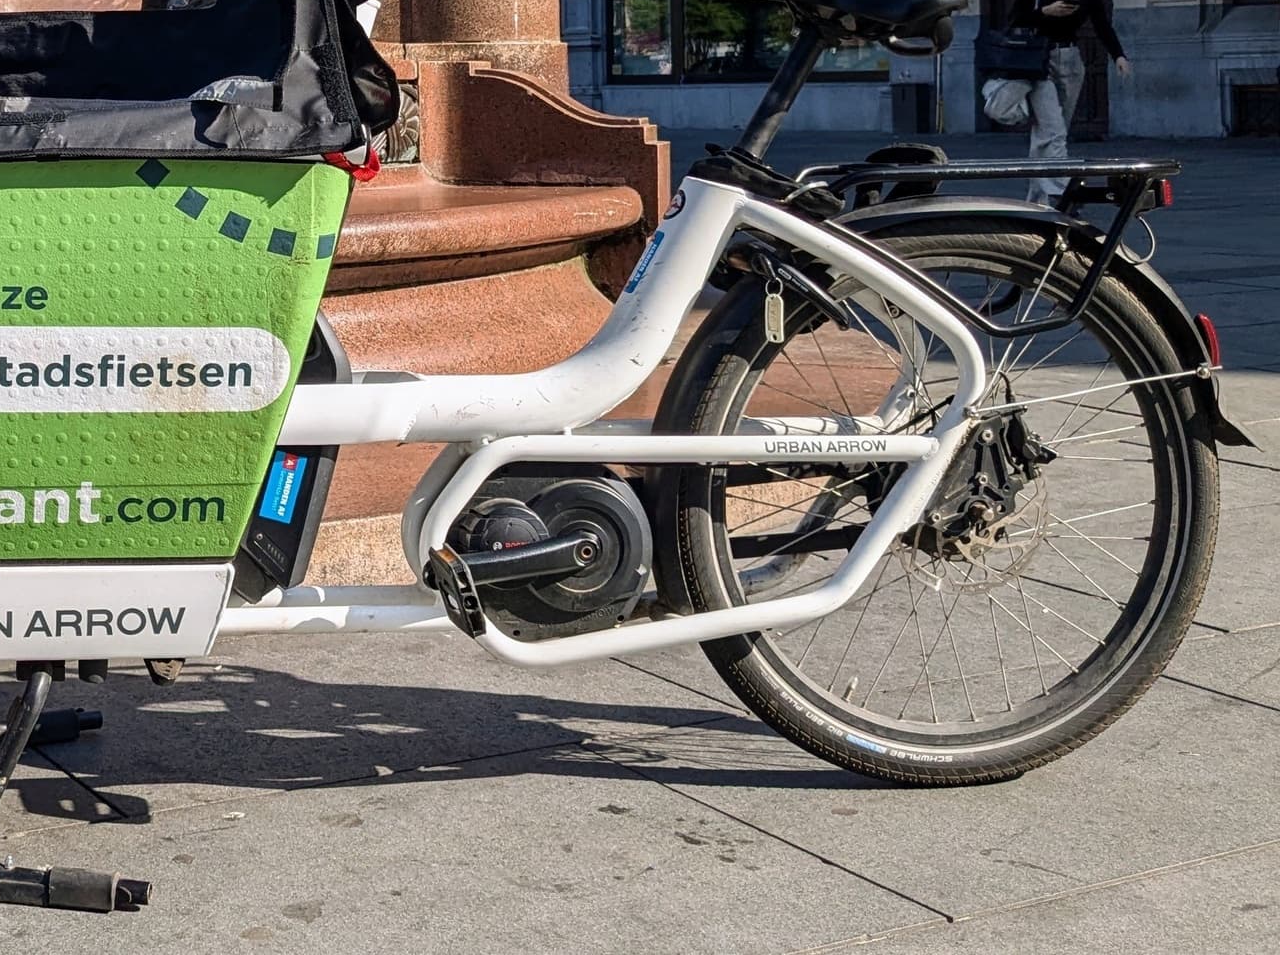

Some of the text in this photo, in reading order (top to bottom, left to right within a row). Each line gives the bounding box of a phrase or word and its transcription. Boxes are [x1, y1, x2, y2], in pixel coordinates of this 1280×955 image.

[764, 440, 887, 453] URBAN ARROW
[280, 472, 295, 505] HANDEN
[23, 607, 186, 638] ARROW
[889, 749, 953, 763] SCHWALBE
